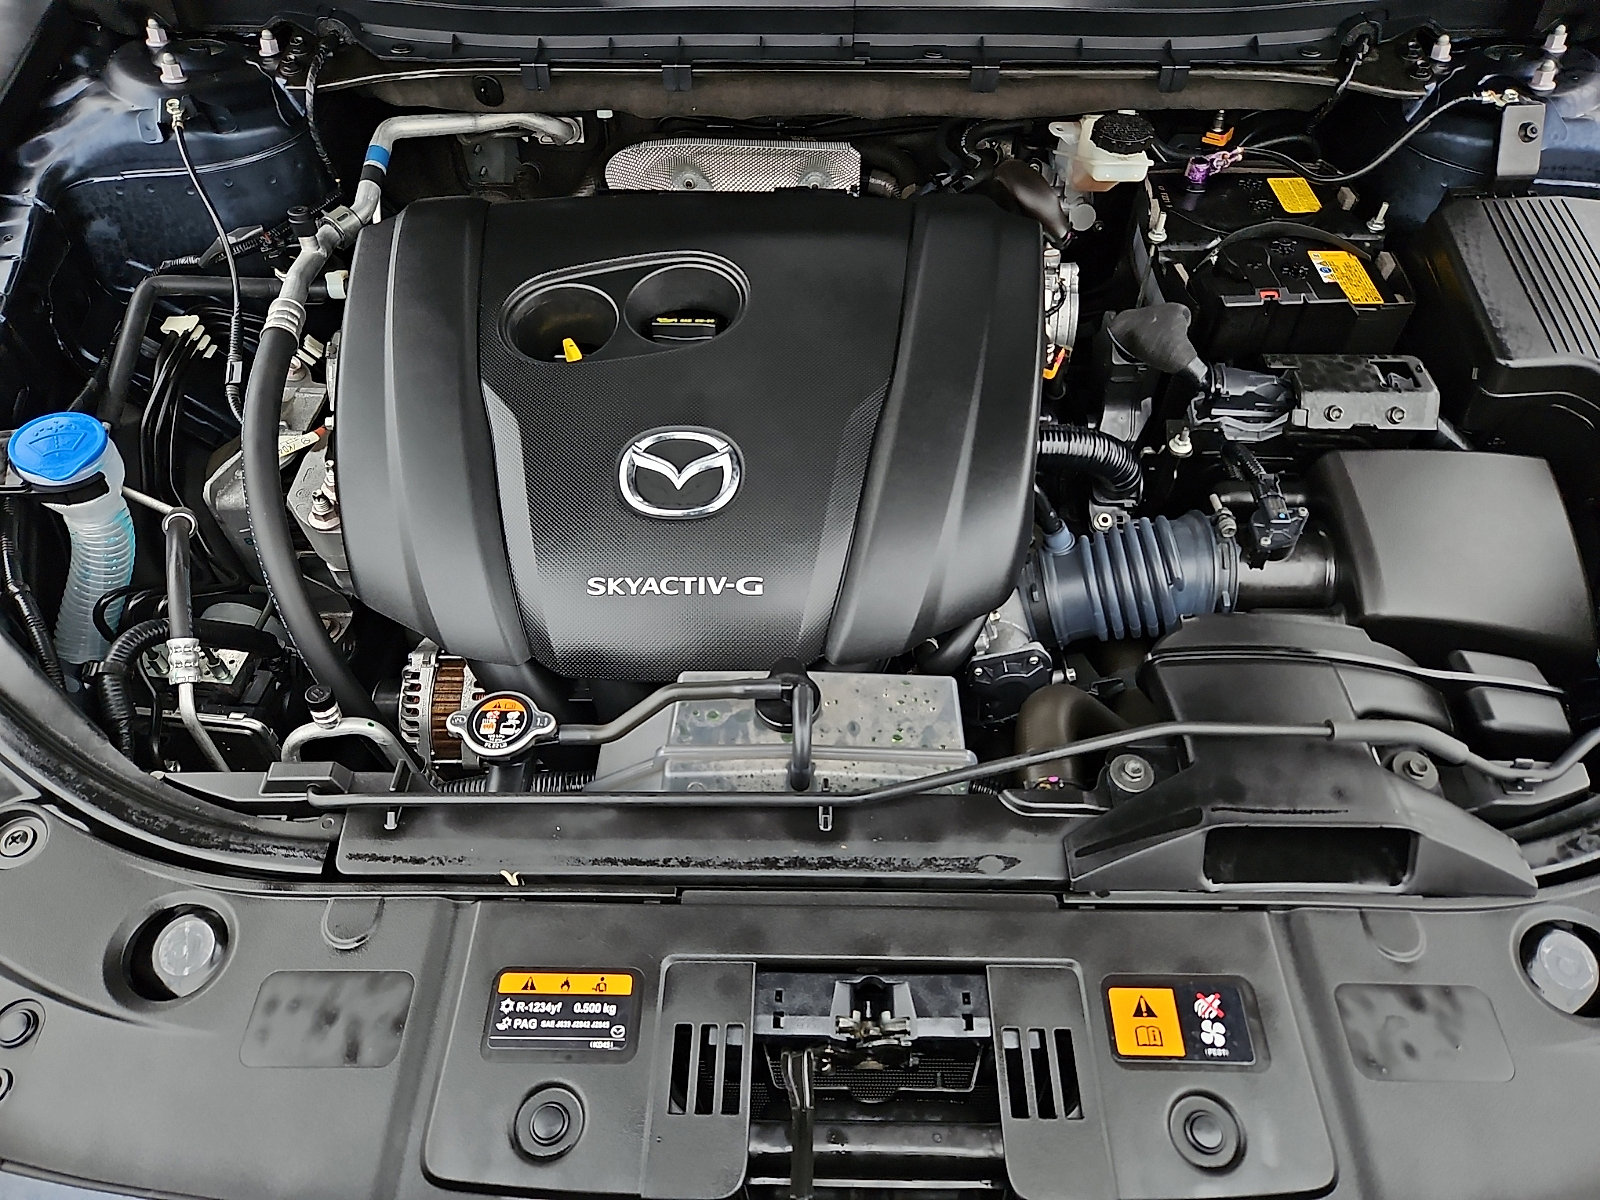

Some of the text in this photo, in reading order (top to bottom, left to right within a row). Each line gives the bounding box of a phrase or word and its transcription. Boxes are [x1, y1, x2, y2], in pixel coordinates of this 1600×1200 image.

[586, 576, 764, 596] SKYACTIV-G
[515, 1001, 617, 1016] R-1234yf 0.500 kg
[513, 1018, 538, 1030] PAG
